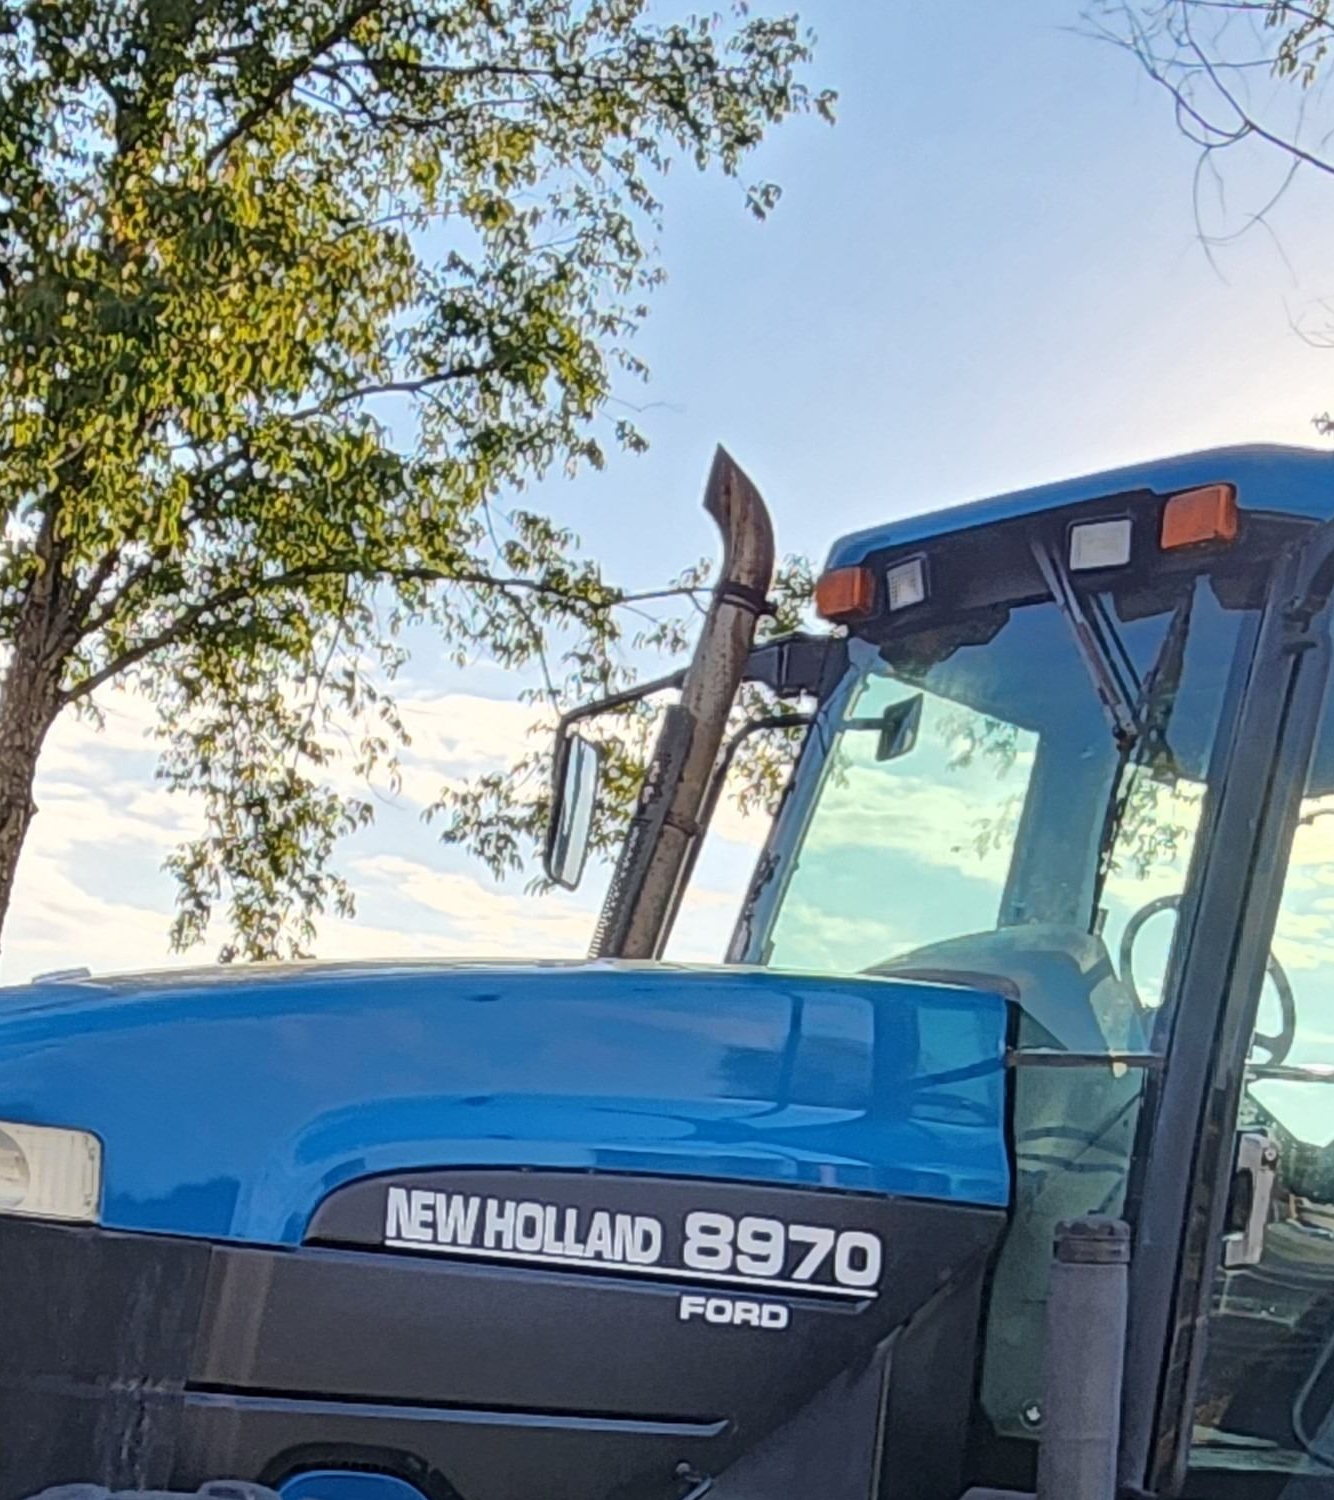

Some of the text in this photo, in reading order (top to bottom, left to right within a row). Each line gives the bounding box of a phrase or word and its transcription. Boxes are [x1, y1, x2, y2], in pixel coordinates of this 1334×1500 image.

[385, 1187, 882, 1286] NEW HOLLAND 8970
[679, 1297, 789, 1329] FORD
